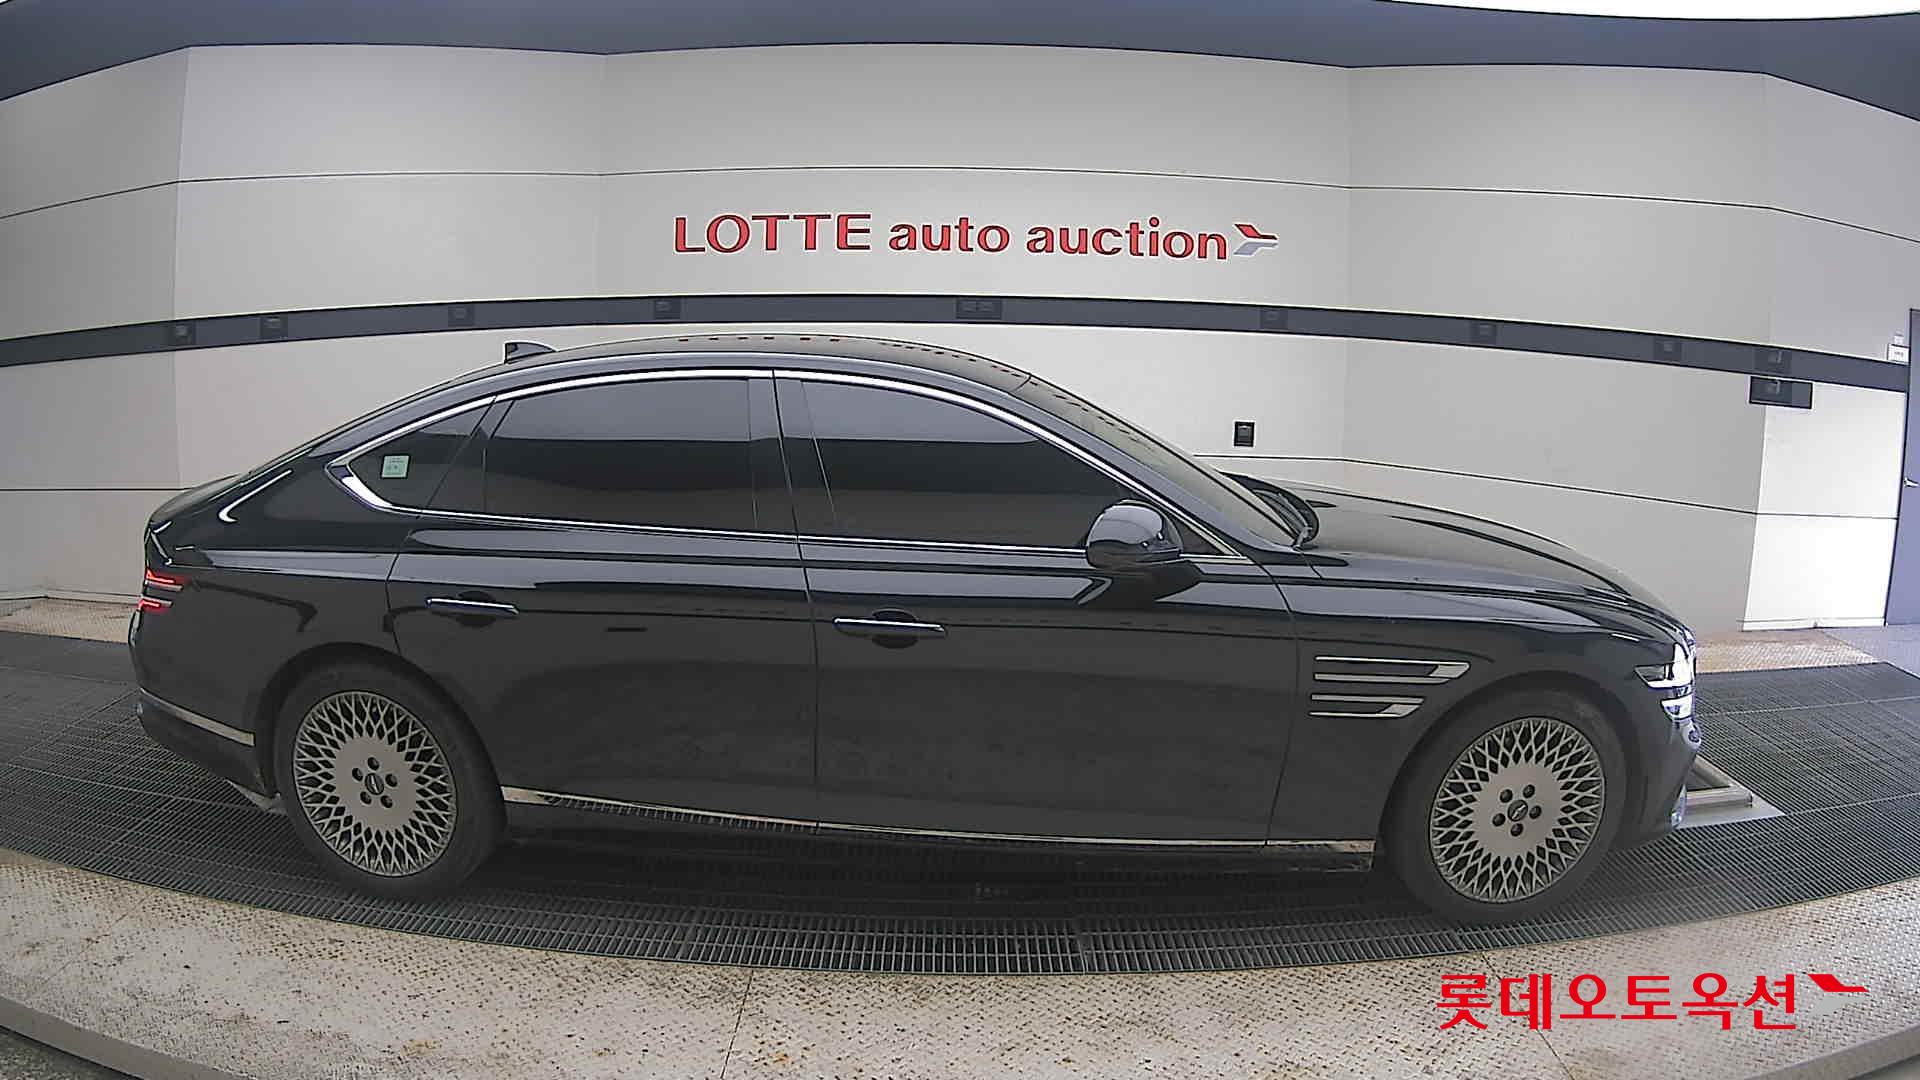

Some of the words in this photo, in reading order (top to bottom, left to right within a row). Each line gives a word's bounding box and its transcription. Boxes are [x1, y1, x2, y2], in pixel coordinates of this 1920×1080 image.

[675, 214, 872, 253] LOTTE
[888, 217, 1011, 252] auto
[1026, 217, 1228, 260] auction
